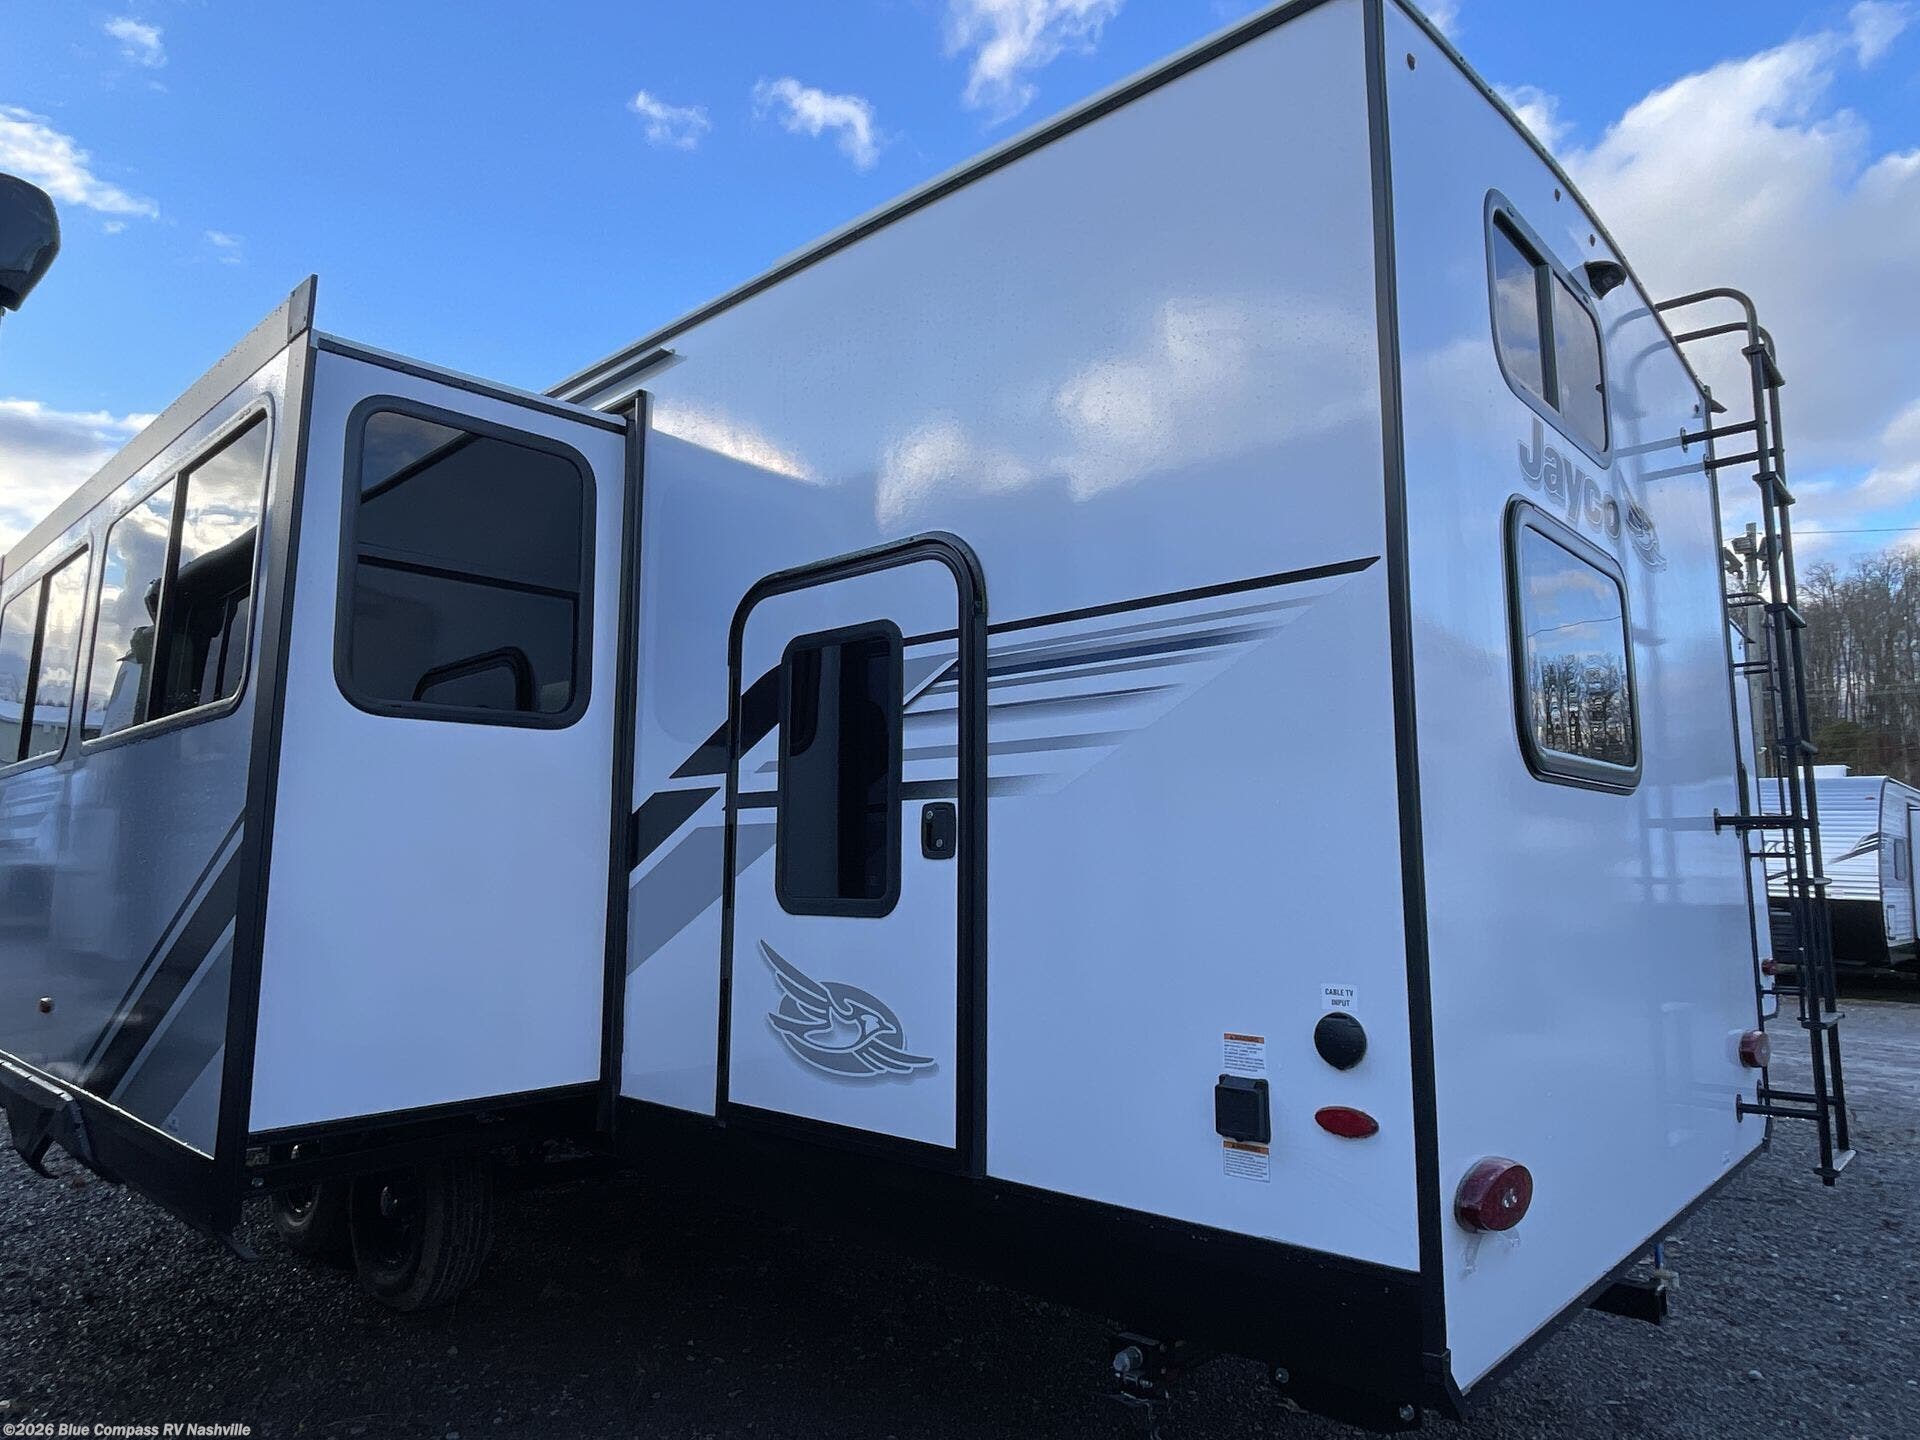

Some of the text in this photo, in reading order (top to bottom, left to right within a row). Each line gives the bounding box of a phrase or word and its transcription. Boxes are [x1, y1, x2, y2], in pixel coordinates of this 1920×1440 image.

[1518, 415, 1621, 542] Jayco
[1325, 988, 1353, 997] CABLE TV
